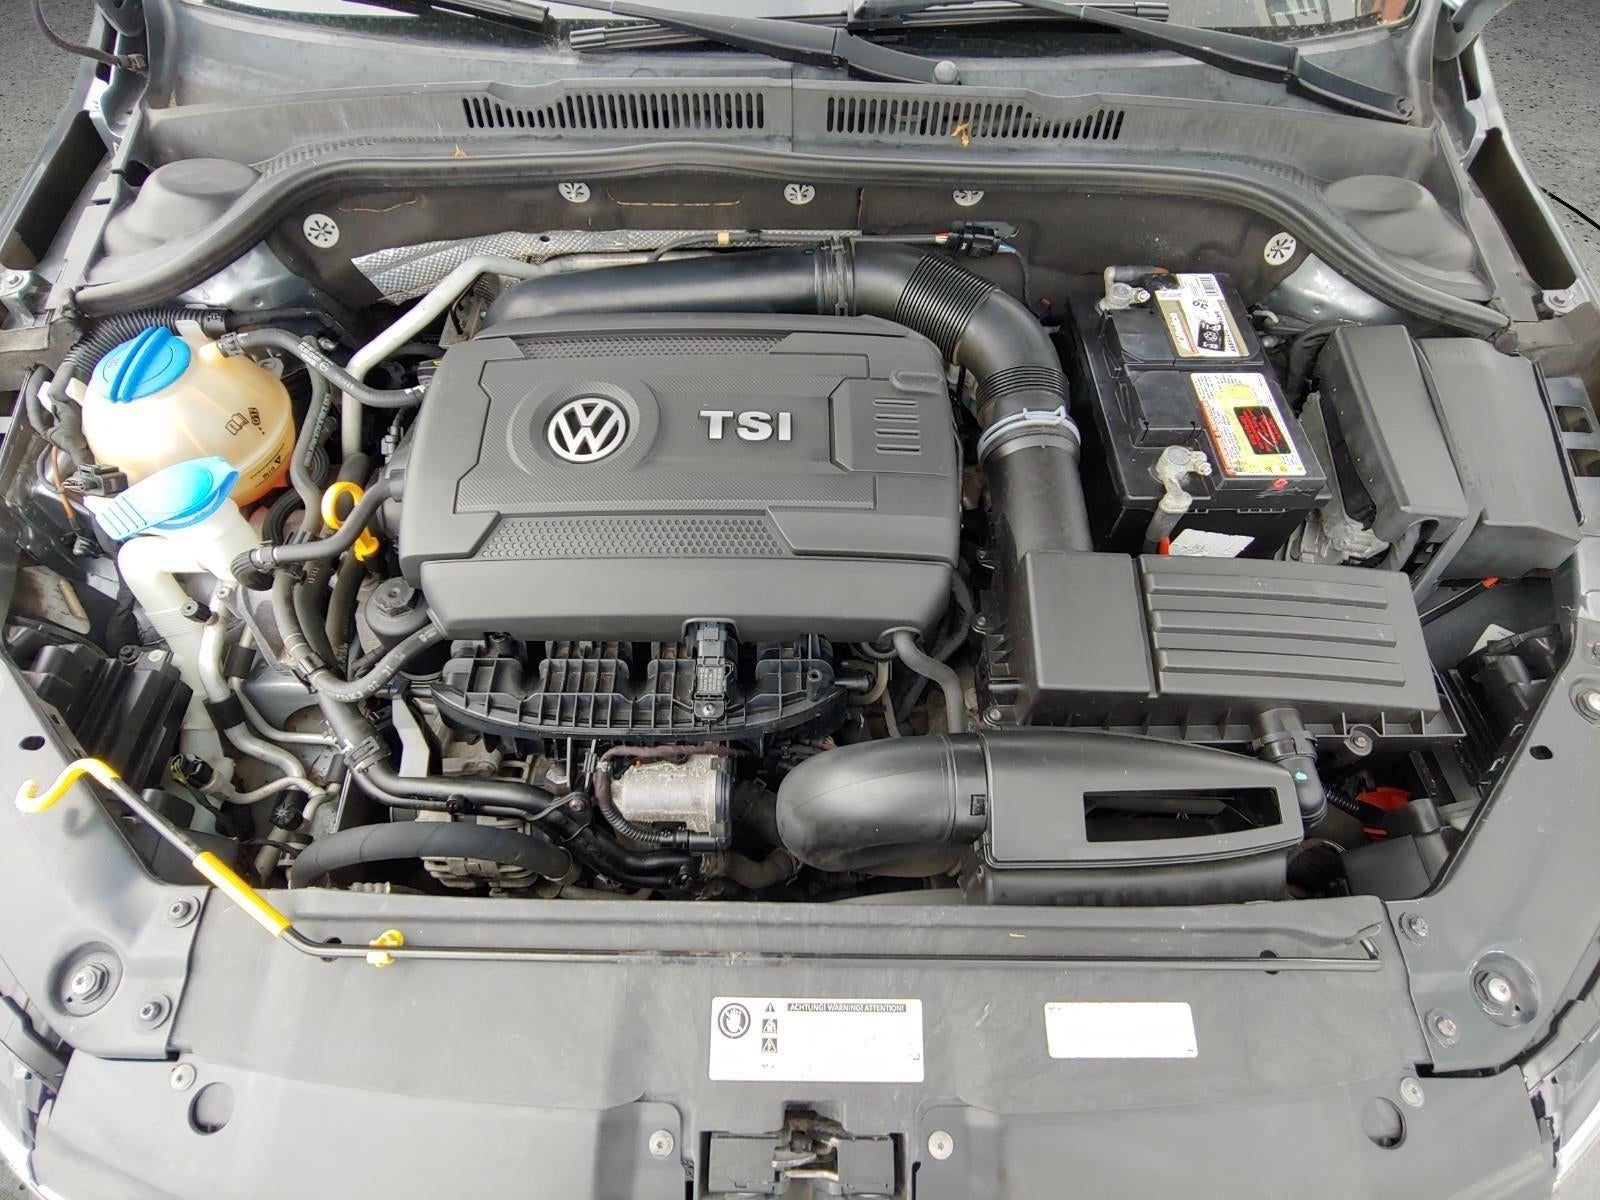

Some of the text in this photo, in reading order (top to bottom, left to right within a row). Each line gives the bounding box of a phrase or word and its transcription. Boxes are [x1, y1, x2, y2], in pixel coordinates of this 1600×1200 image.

[548, 398, 626, 462] VW
[699, 410, 792, 442] TSI
[262, 466, 276, 480] min
[789, 1003, 905, 1013] ACHTUNG! WARNING! ATTENTION!
